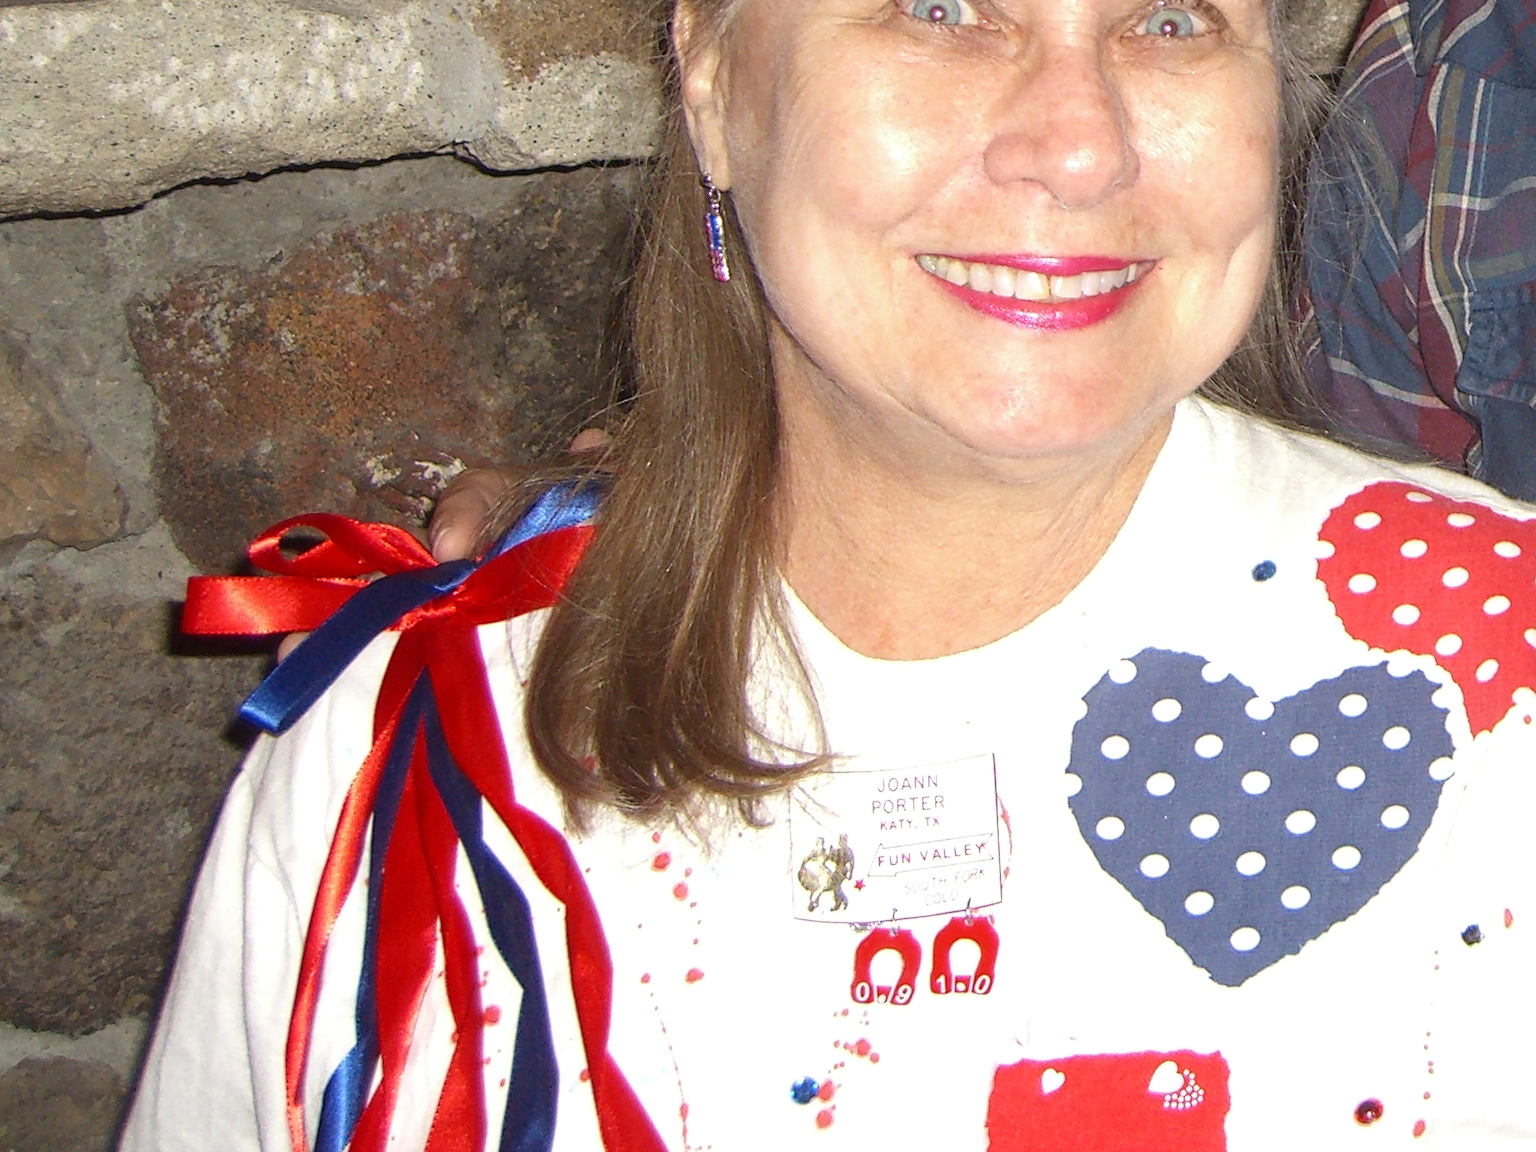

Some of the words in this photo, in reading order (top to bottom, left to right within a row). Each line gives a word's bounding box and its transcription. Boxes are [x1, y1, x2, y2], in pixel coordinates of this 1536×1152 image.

[877, 774, 939, 793] JOANN
[871, 795, 945, 814] PORTER
[924, 816, 941, 827] TX
[877, 852, 911, 867] FUN
[920, 841, 987, 862] VALLEY
